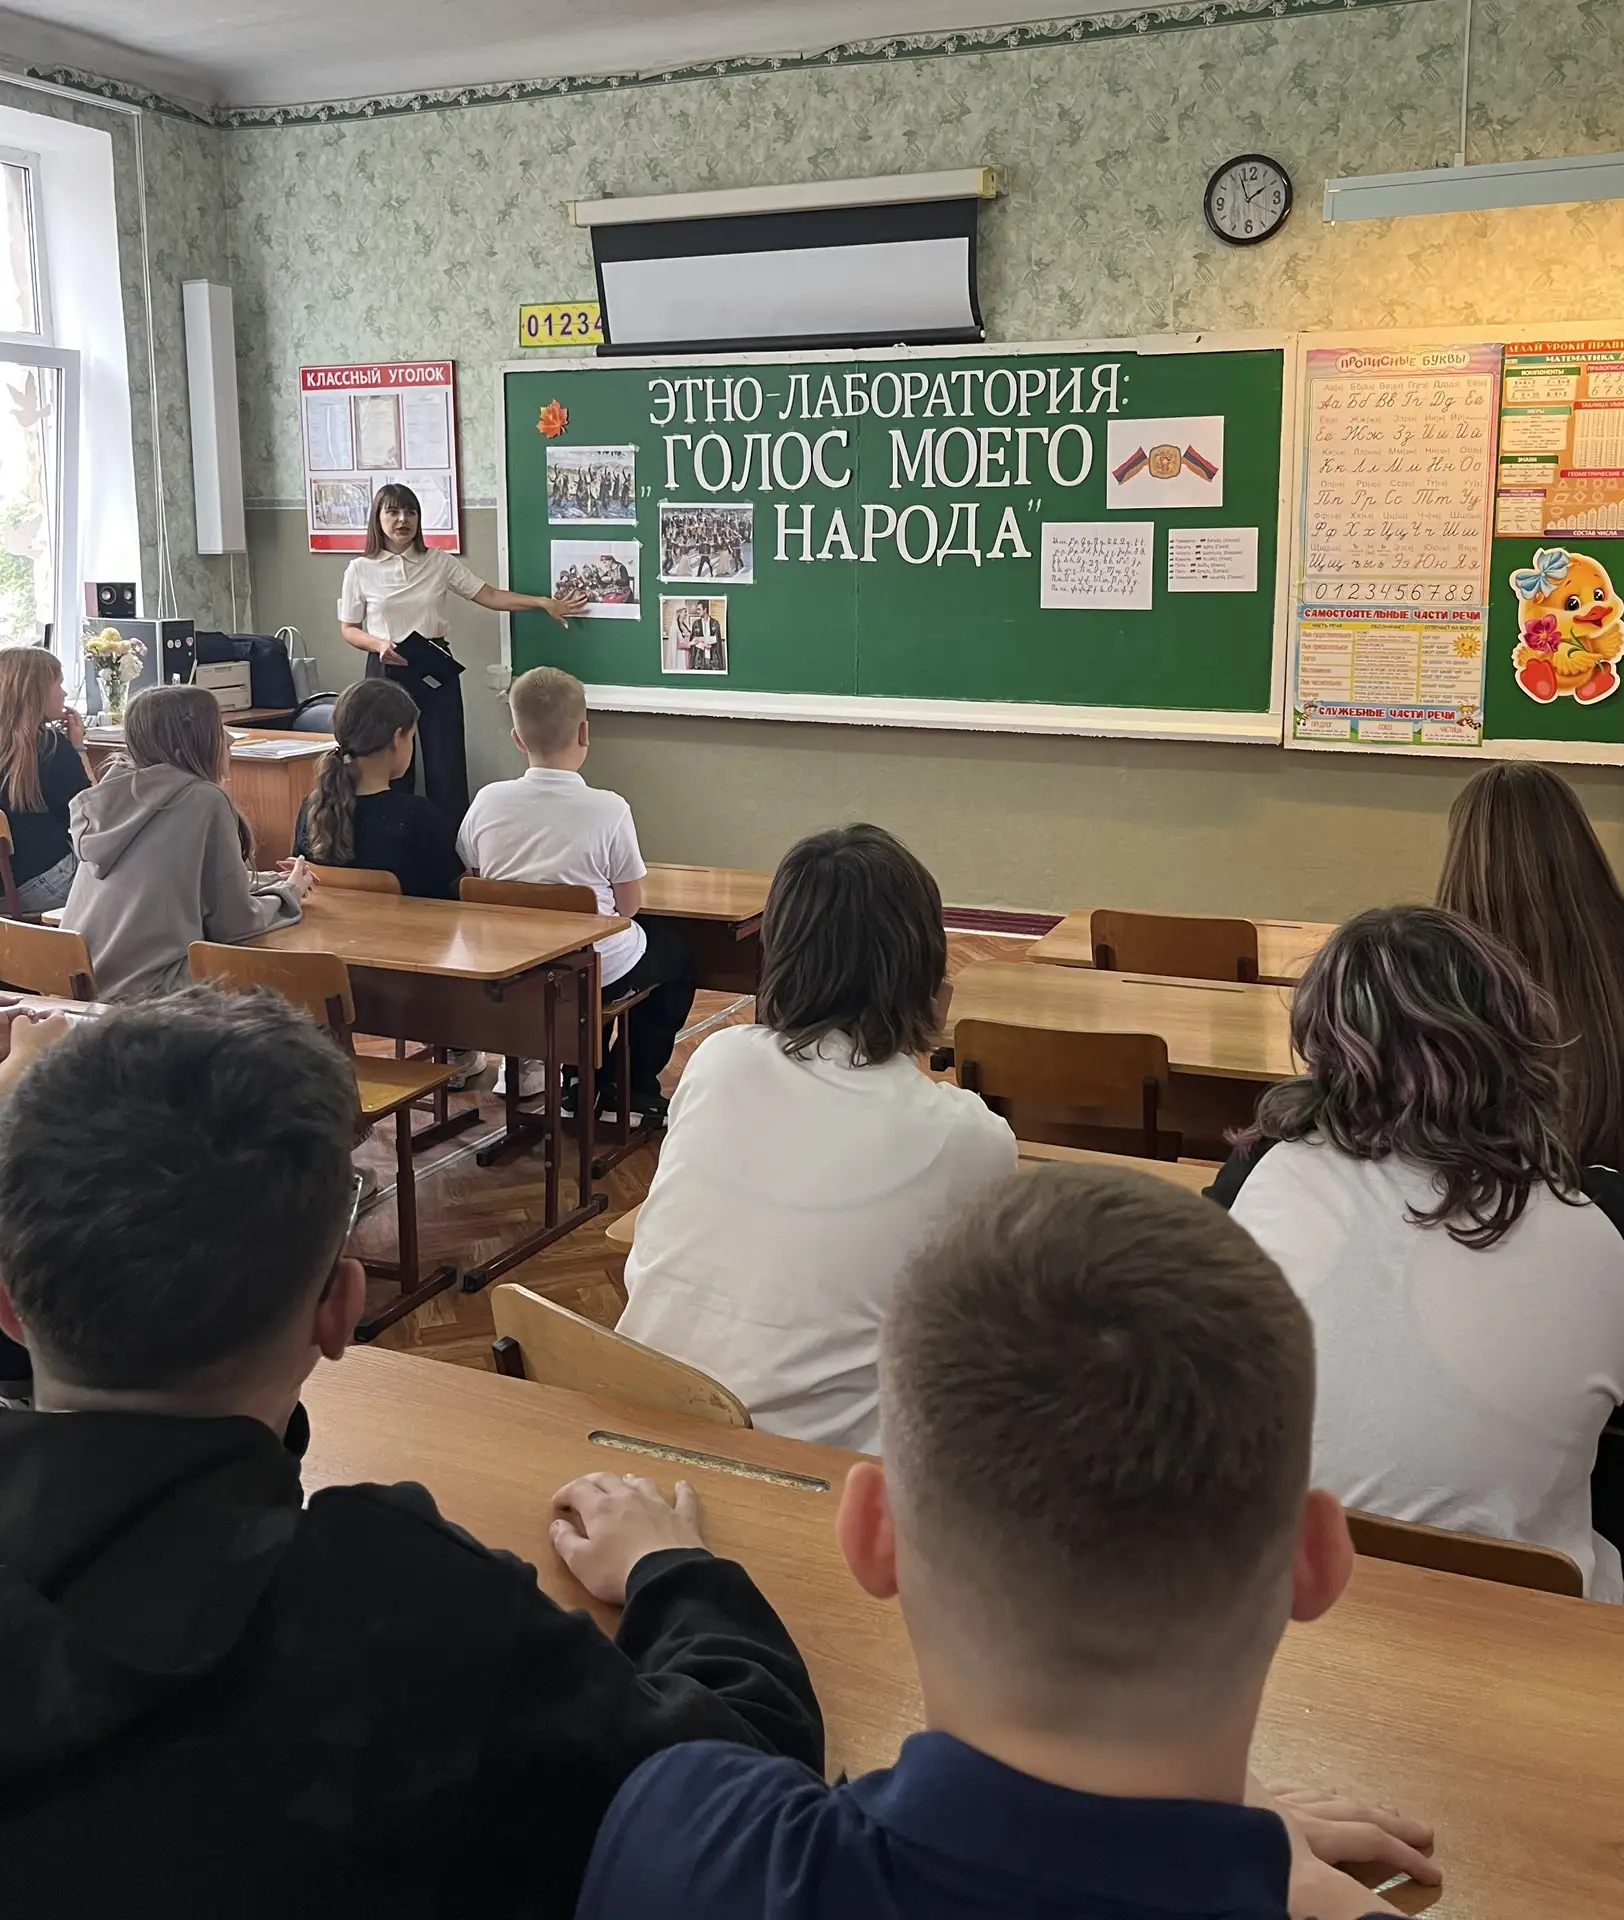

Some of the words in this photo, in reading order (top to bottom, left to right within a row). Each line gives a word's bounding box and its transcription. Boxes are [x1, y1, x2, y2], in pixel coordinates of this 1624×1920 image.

[1241, 166, 1258, 182] 12
[1216, 196, 1225, 212] 9
[1272, 190, 1282, 205] 3
[1244, 219, 1254, 234] 6
[1546, 341, 1584, 351] УРОКИ
[1340, 355, 1416, 369] ПРОПИСНЫЕ
[1422, 354, 1466, 366] БУКВЫ
[1545, 354, 1615, 363] МАТЕМАТИКА
[306, 367, 381, 387] КЛАССНЫЙ
[388, 366, 445, 383] УГОЛОК
[648, 363, 1130, 425] ЭТНО-ЛАБОРАТОРИЯ:
[888, 424, 1094, 489] МОЕГО
[1304, 609, 1409, 619] САМОСТОЯТЕЛЬНЫЕ
[1414, 610, 1448, 620] ЧАСТИ
[1452, 610, 1481, 620] РЕЧИ
[1318, 706, 1385, 717] СЛУЖЕБНЫЕ
[1389, 709, 1424, 719] ЧАСТИ
[1427, 710, 1456, 720] РЕЧИ
